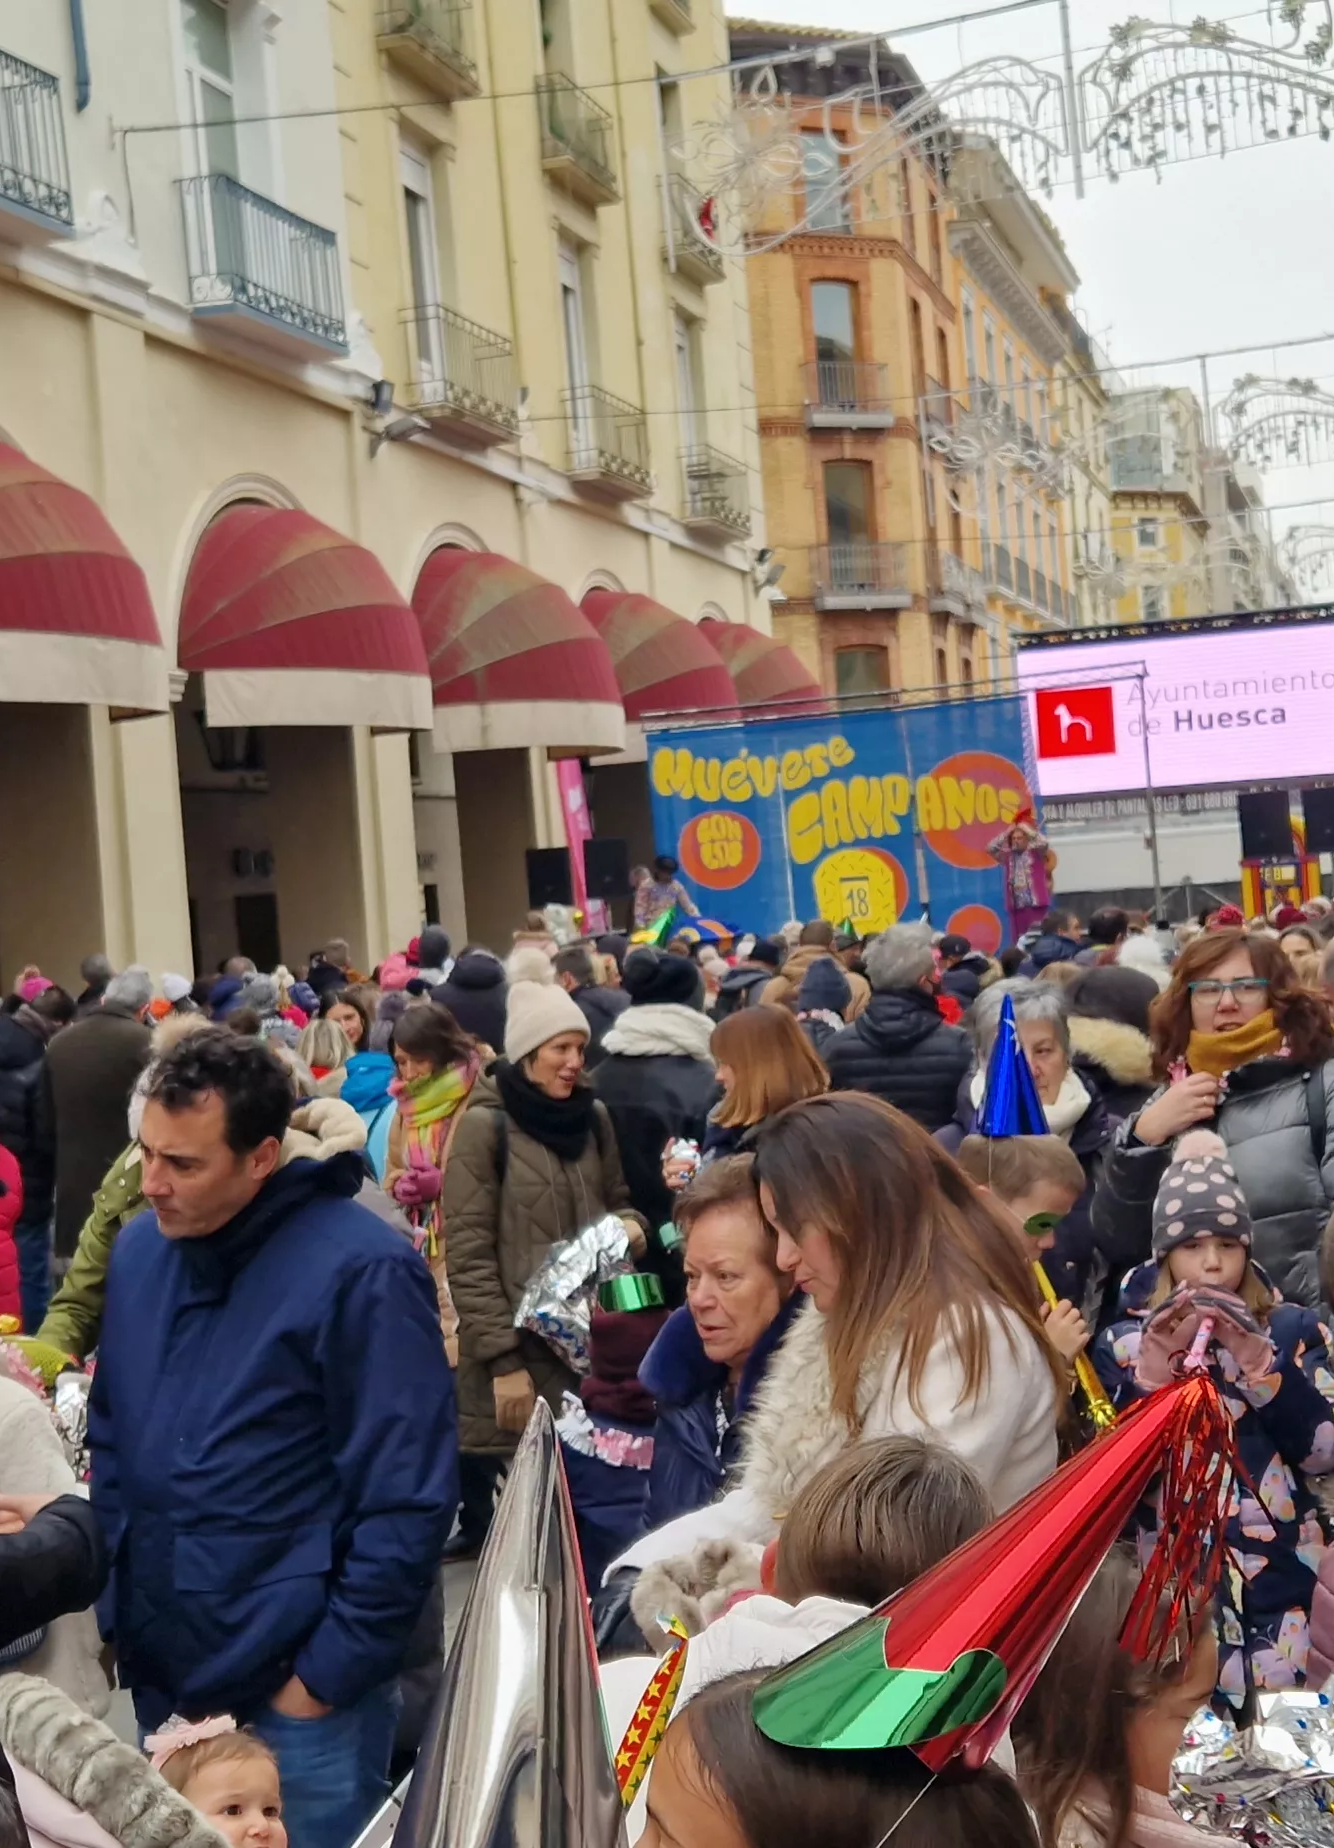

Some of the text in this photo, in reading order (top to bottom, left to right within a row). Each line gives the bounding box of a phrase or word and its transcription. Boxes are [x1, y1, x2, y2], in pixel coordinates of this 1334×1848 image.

[1127, 706, 1287, 737] de Huesca
[845, 887, 869, 917] 18
